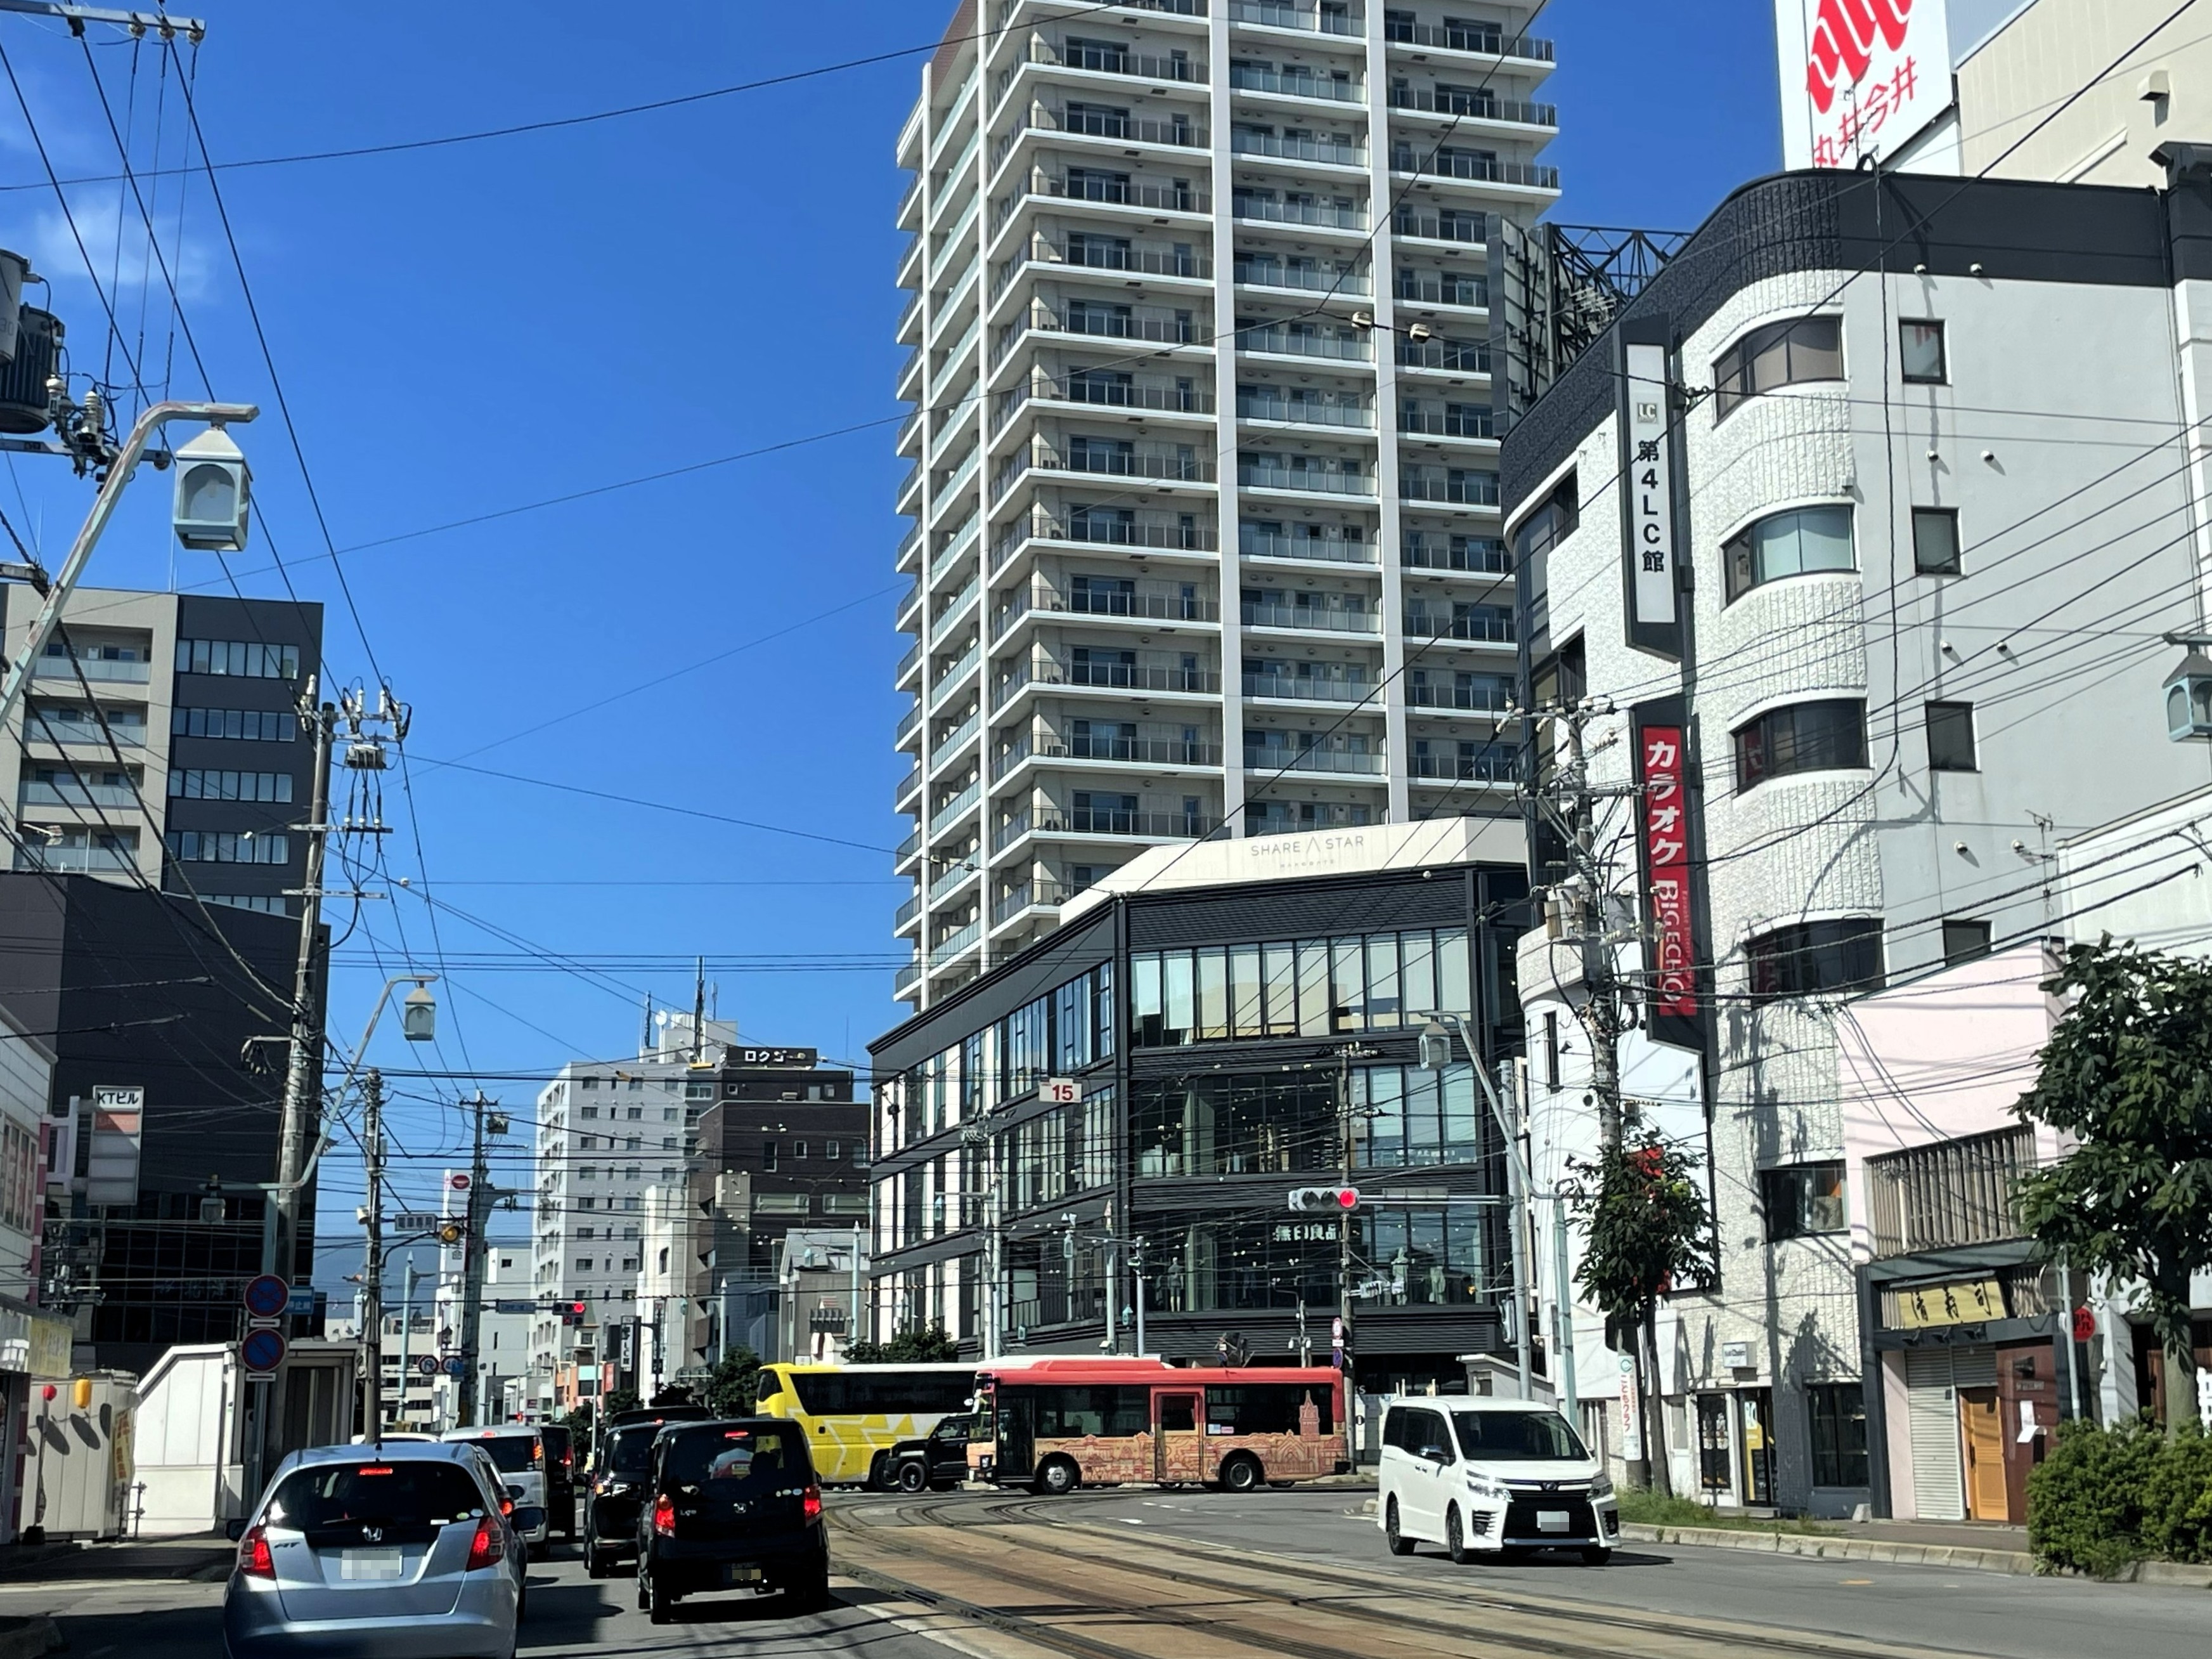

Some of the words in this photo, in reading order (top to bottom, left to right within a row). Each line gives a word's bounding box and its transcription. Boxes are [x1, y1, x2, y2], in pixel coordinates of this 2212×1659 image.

[1639, 404, 1656, 419] LC
[1638, 440, 1664, 573] 第4LC館
[1647, 741, 1683, 866] カラオケ
[1251, 841, 1301, 857] SHARE
[1324, 835, 1364, 850] STAR
[1655, 880, 1680, 927] BIG
[1662, 931, 1685, 1002] ECHO
[97, 1092, 139, 1105] KTビル
[1052, 1084, 1073, 1101] 15
